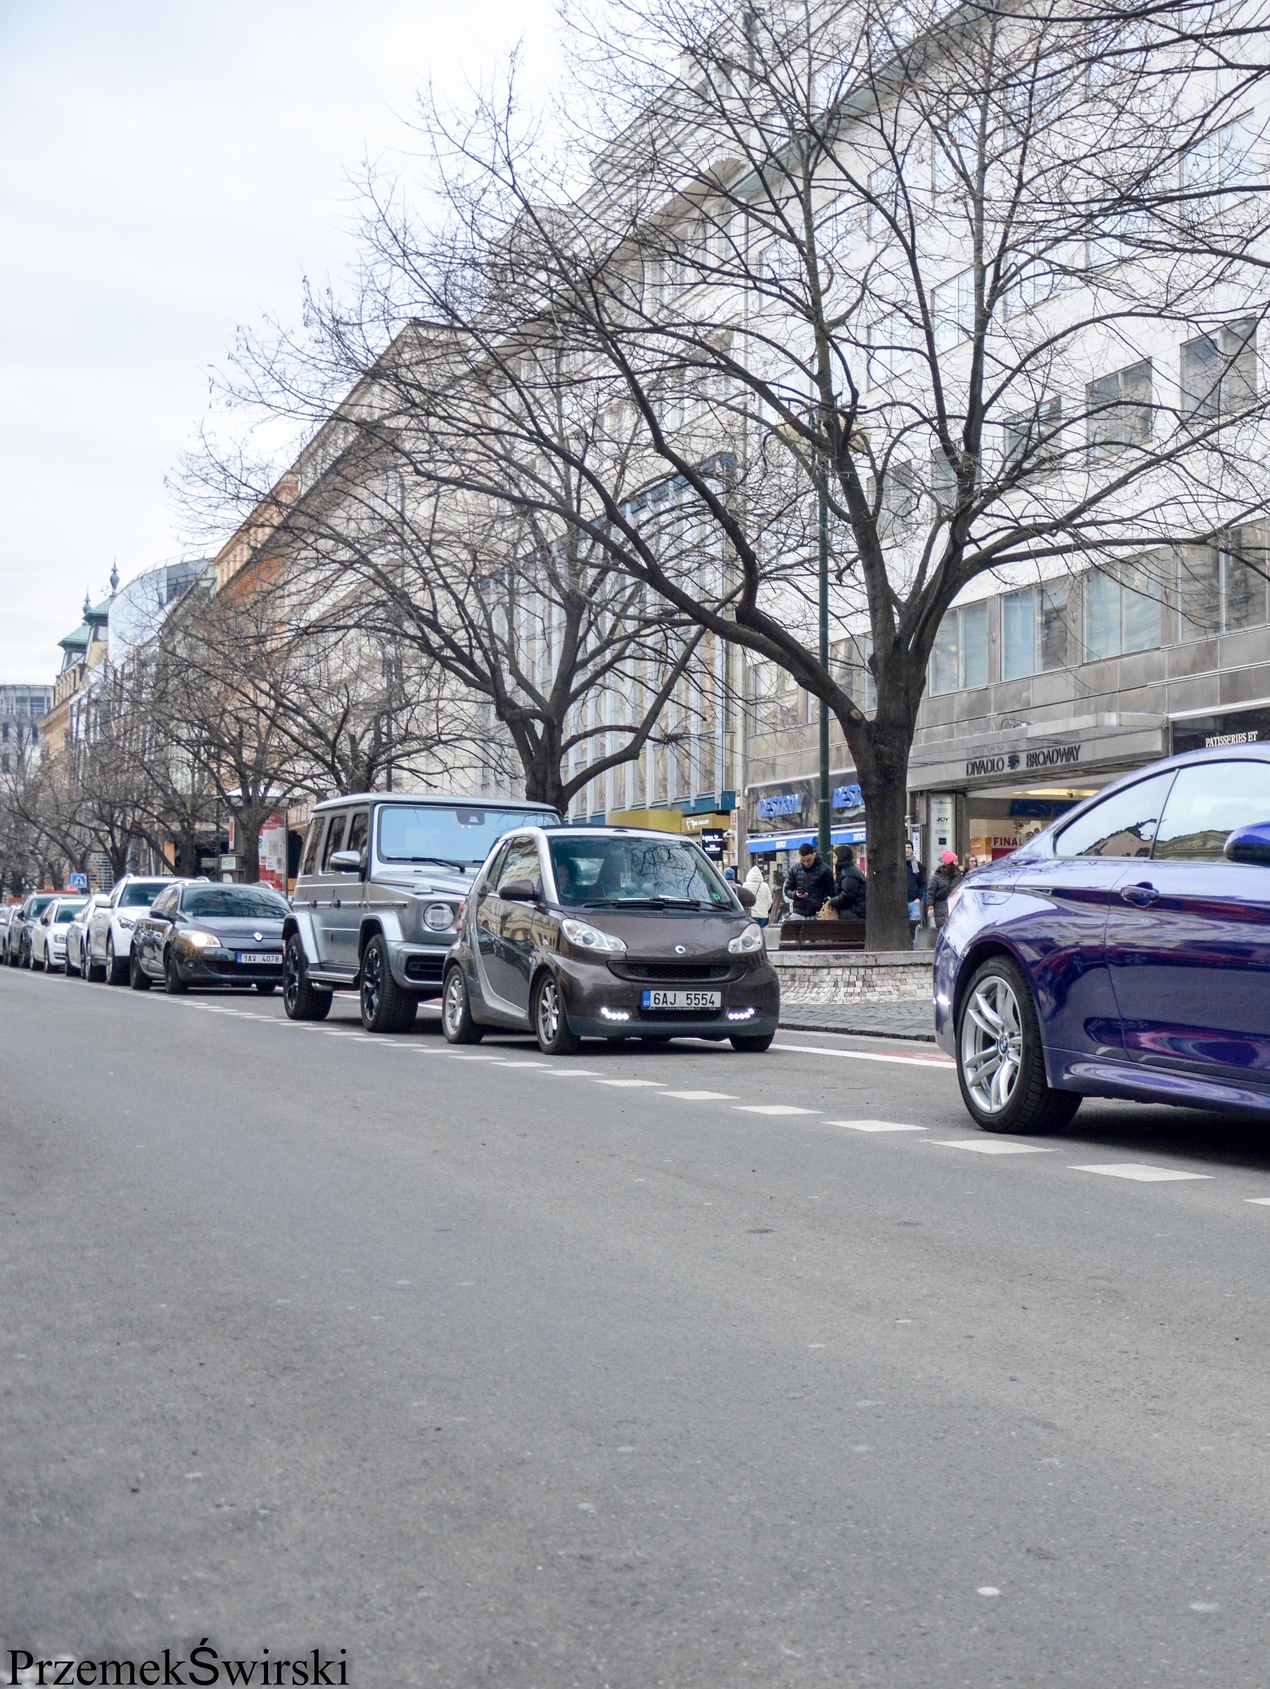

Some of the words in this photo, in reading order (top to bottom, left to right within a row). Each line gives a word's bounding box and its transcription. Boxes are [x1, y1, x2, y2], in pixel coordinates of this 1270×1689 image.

[1205, 732, 1247, 748] PATISSERIES
[1247, 730, 1258, 743] ET
[966, 756, 1005, 776] DIVADLO
[1026, 744, 1081, 769] BROADWAY
[993, 837, 1023, 847] FINAL
[653, 992, 677, 1006] 6AJ
[686, 993, 715, 1006] 5554
